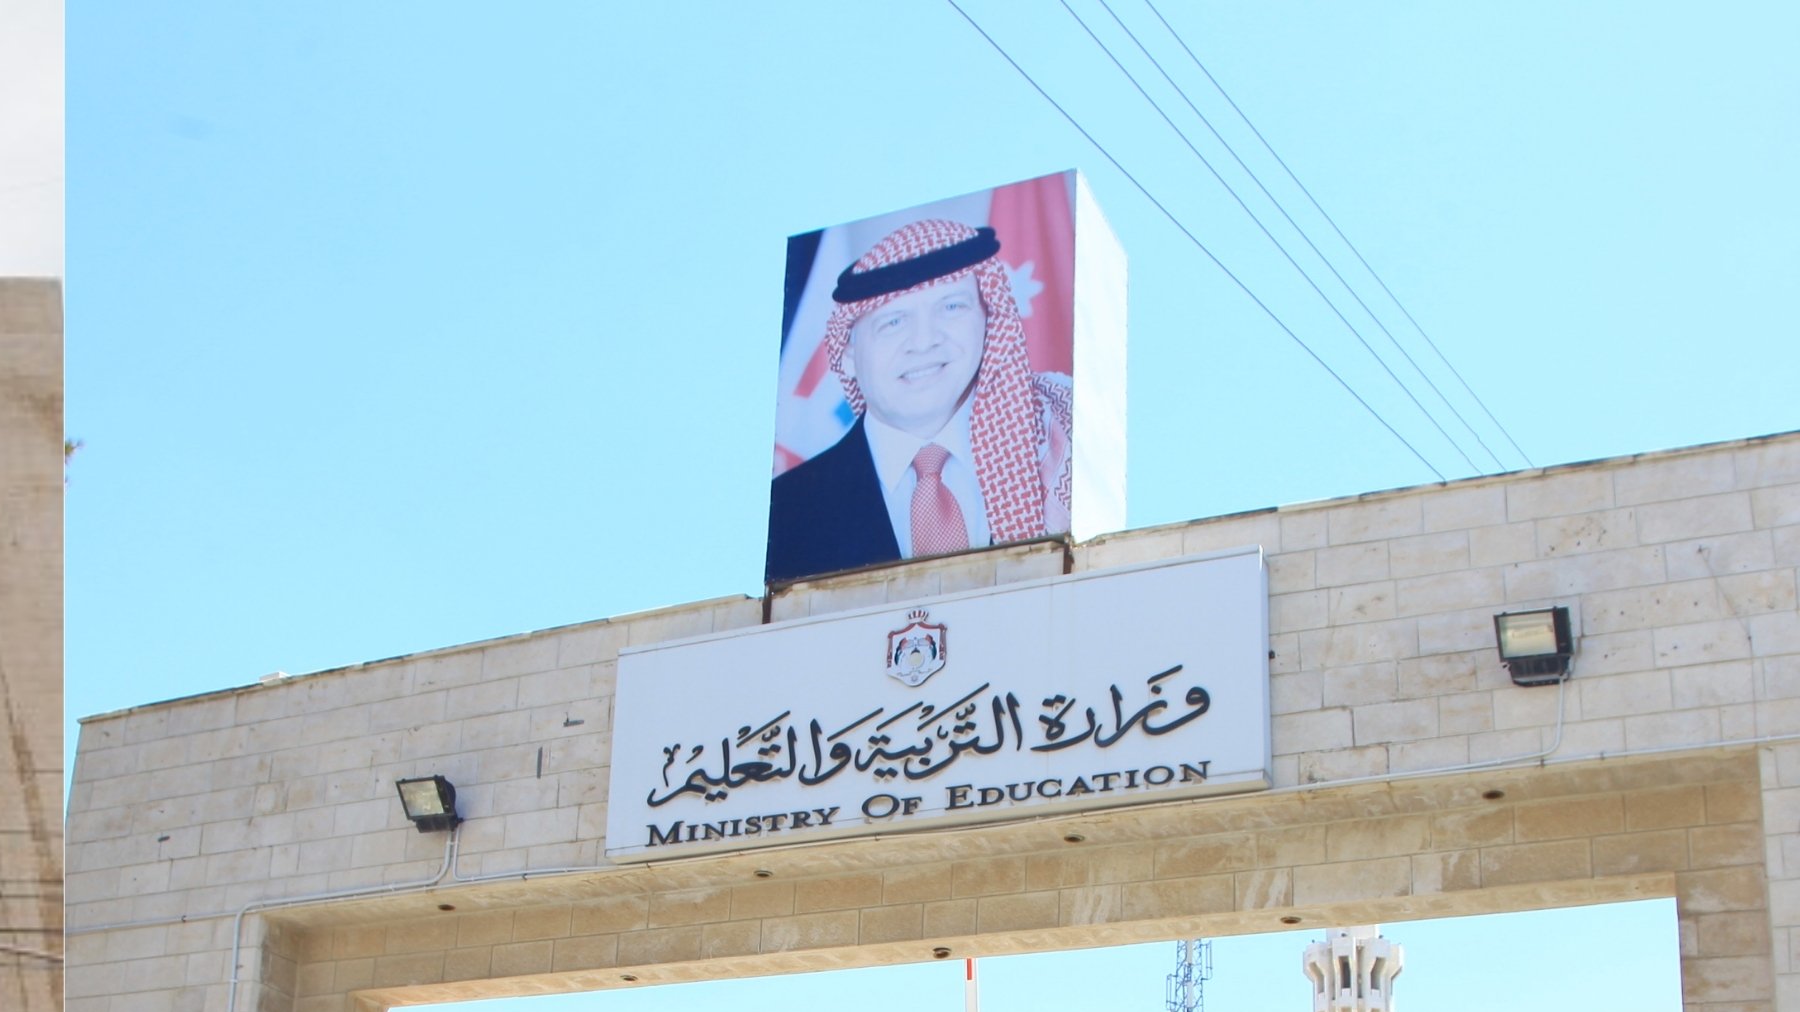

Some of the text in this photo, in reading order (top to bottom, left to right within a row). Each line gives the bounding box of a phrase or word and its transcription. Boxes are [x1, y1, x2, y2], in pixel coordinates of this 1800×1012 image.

[646, 664, 1211, 808] وزارة التربية والتعليم
[645, 760, 1212, 848] MINISTRY OF EDUCATION
